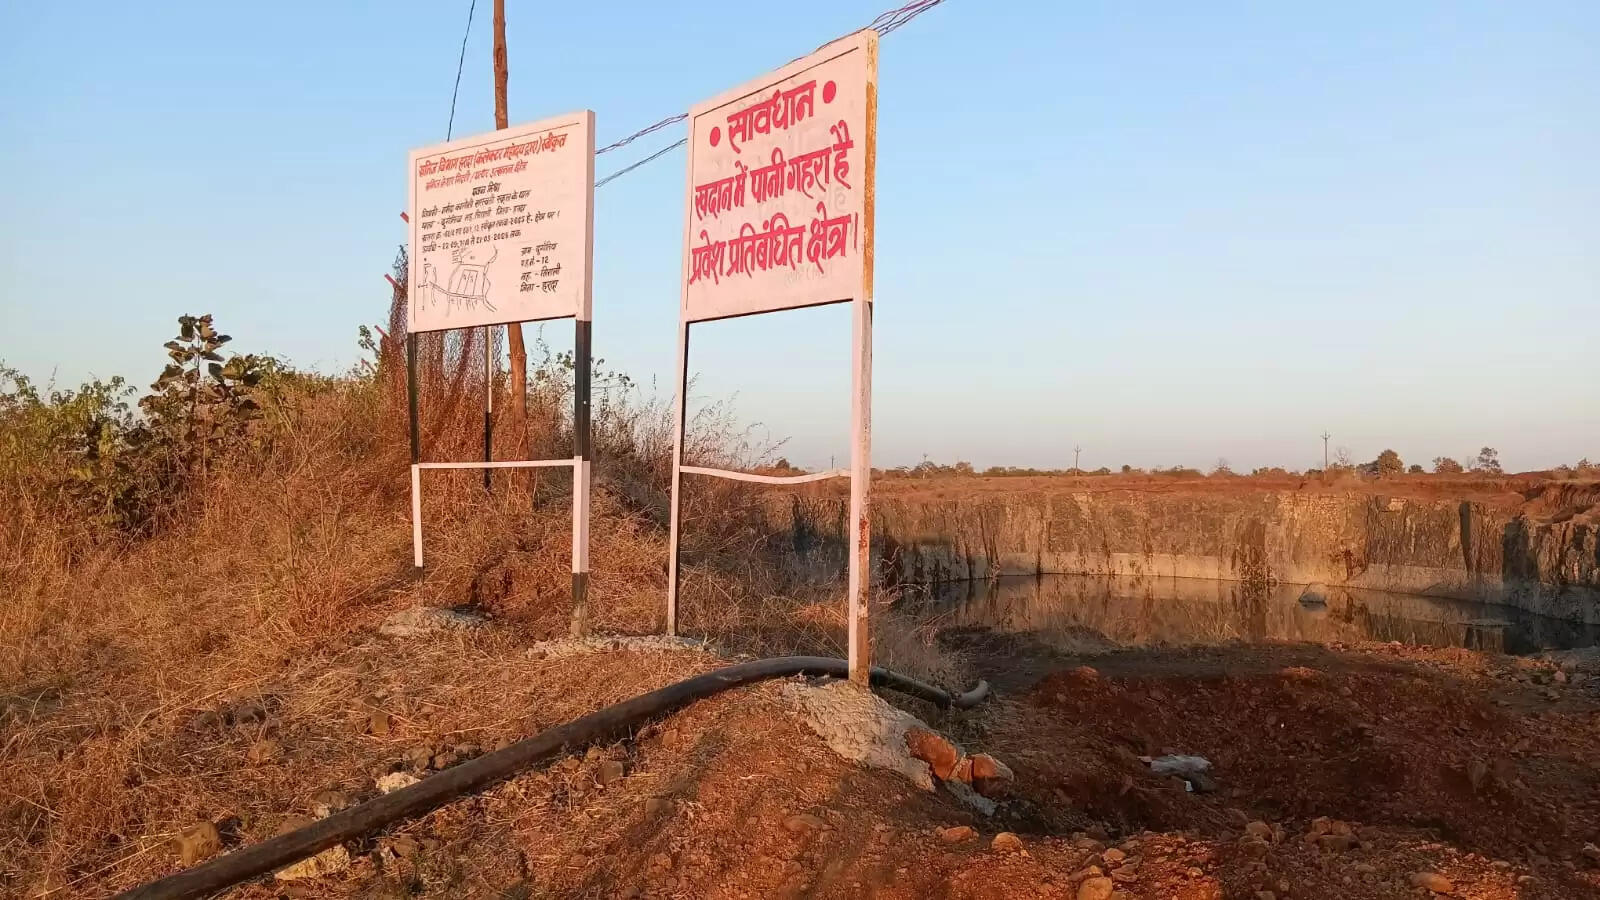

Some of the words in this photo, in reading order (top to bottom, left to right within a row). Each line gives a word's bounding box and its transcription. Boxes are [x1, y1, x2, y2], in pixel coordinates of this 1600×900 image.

[727, 79, 817, 154] सावधान
[695, 176, 735, 221] खदान
[734, 160, 748, 207] में
[750, 147, 786, 203] पानी
[787, 146, 832, 199] गहरा
[830, 119, 854, 189] है
[689, 229, 726, 285] प्रवेश
[726, 212, 806, 279] प्रतिबंधित
